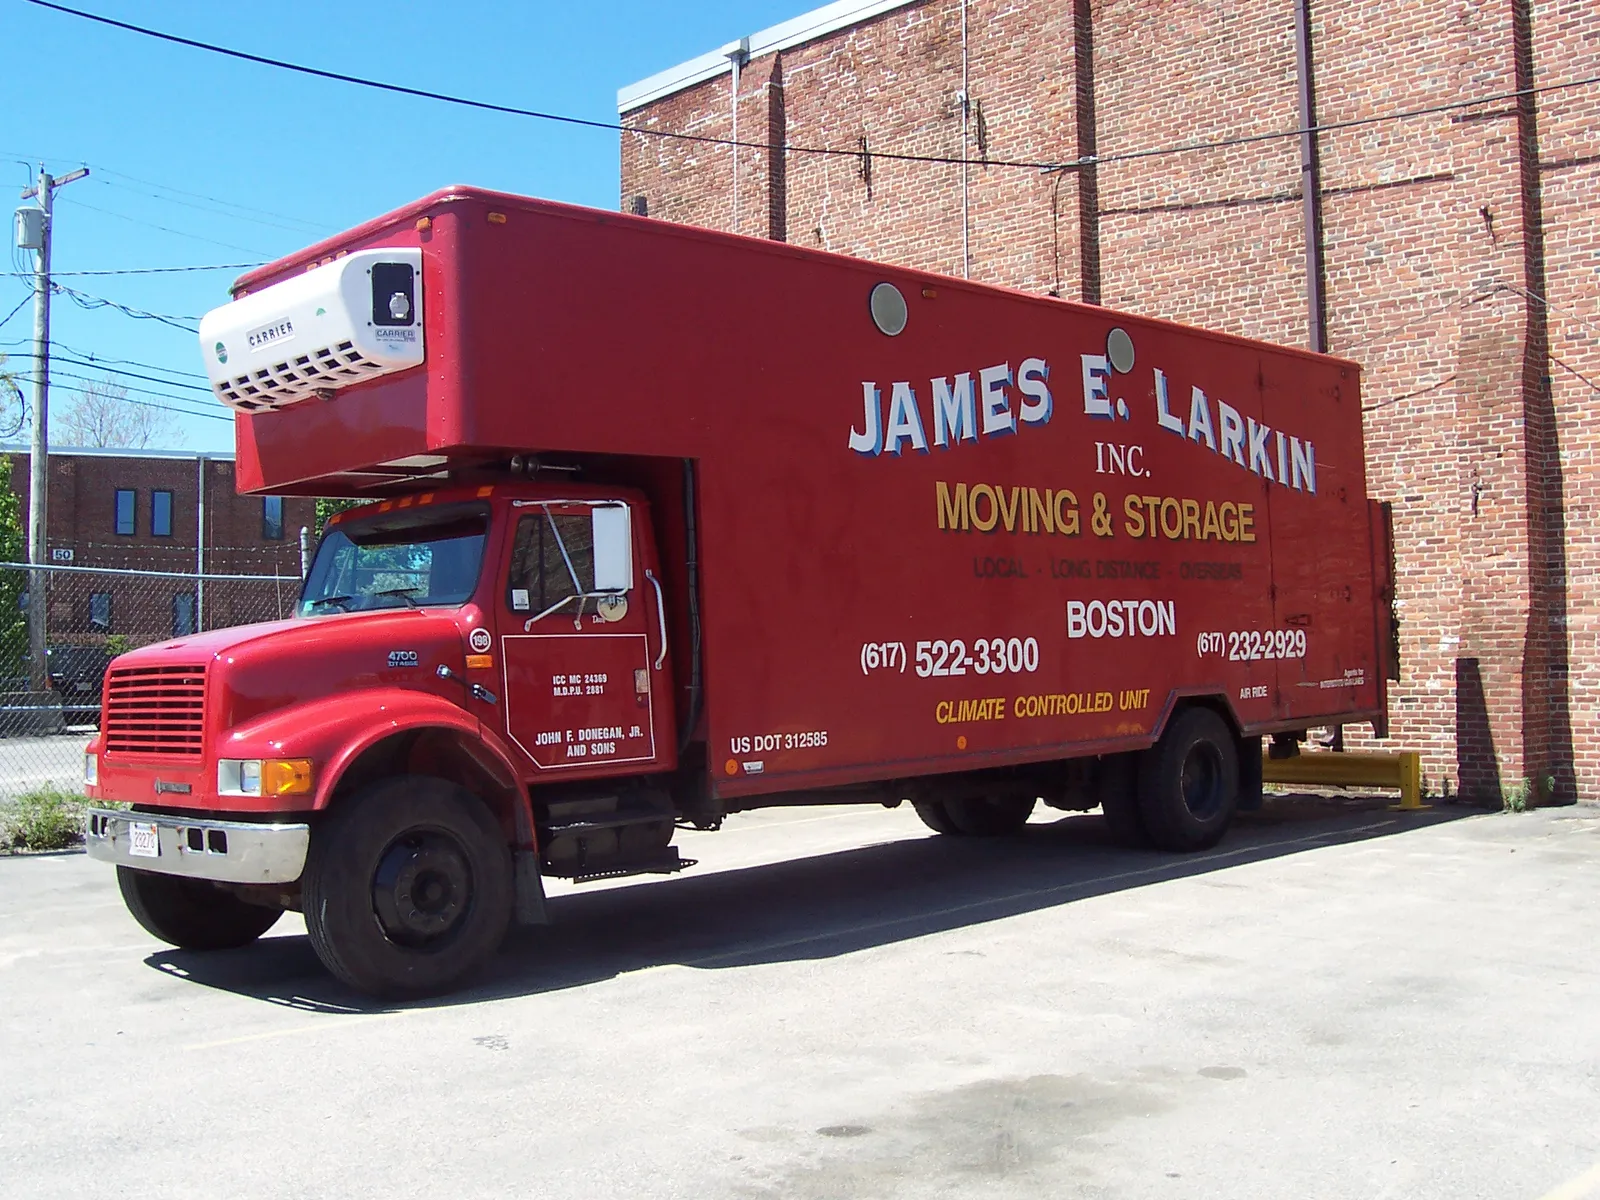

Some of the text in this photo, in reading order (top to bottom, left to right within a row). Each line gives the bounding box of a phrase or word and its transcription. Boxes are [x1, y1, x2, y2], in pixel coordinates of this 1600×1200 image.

[249, 321, 294, 346] CARRIER
[848, 354, 1317, 495] JAMES E. LARKIN
[1094, 442, 1151, 477] INC.
[935, 481, 1256, 542] MOVING & STORAGE
[55, 550, 71, 559] 50
[974, 556, 1028, 579] LOCAL
[1050, 559, 1091, 580] LONG
[1096, 560, 1160, 580] DISTANCE
[1179, 561, 1243, 581] OVERSEAS
[1067, 600, 1176, 638] BOSTON
[388, 651, 418, 660] 4700
[861, 637, 1039, 677] (617) 522-3300
[1197, 630, 1306, 661] (617) 232-2929
[552, 675, 566, 685] ICC
[569, 674, 581, 684] MC
[1239, 685, 1268, 699] AIR RIDE
[936, 689, 1150, 724] CLIMATE CONTROLLED UNIT
[535, 726, 643, 745] JOHN F. DONEGAN, JR.
[730, 731, 828, 754] US DOT 312585
[567, 742, 616, 757] AND SONS
